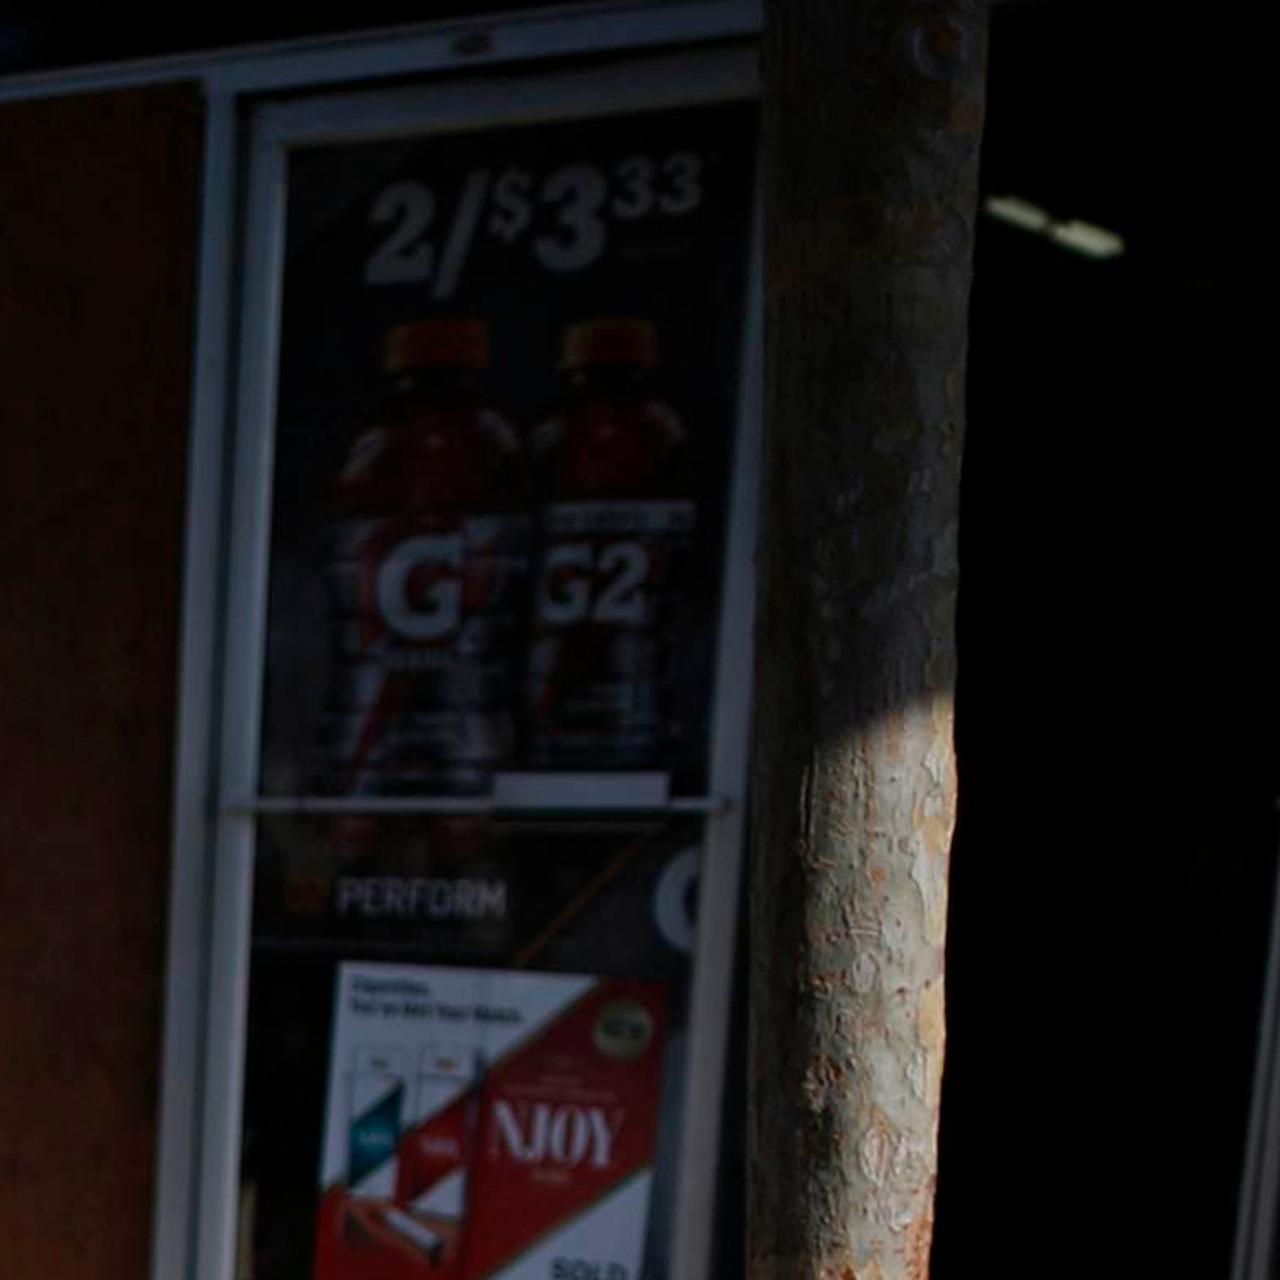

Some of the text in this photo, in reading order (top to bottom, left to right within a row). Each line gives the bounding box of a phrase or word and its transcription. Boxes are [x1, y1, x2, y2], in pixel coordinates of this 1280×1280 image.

[376, 534, 465, 644] G
[537, 541, 651, 625] G2
[337, 877, 507, 919] PERFORM
[487, 1098, 627, 1170] NJOY
